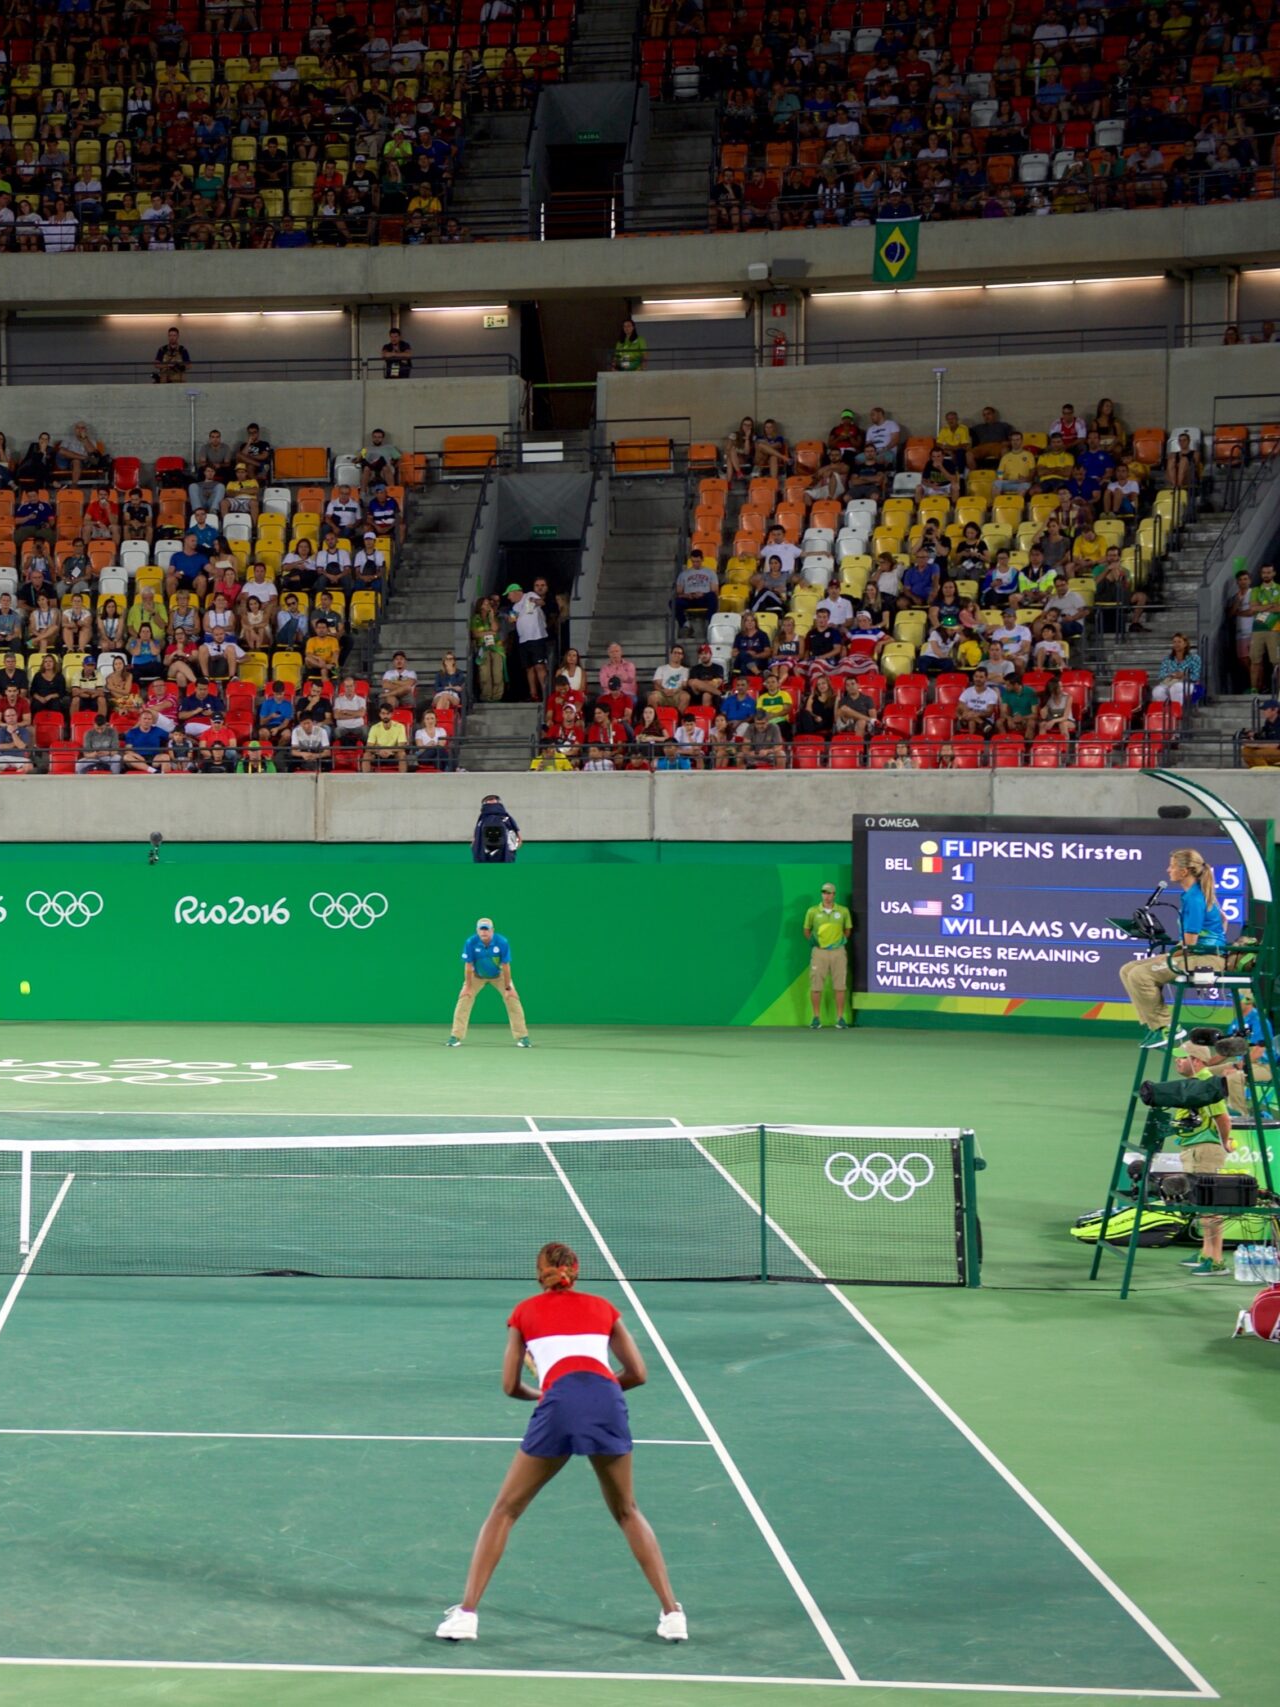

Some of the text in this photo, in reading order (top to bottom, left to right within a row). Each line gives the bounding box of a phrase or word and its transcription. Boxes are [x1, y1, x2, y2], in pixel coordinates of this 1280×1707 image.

[878, 817, 920, 828] OMEGA
[945, 840, 1143, 861] FLIPKENS Kirsten
[885, 858, 912, 871] BEL
[951, 864, 964, 880] 1
[880, 901, 913, 914] USA
[951, 894, 964, 910] 3
[944, 918, 1139, 941] WILLIAMS Venu
[876, 943, 1100, 963] CHALLENGES REMAINING
[876, 961, 1007, 977] FLIPKENS Kirsten
[876, 975, 1007, 991] WILLIAMS Venus
